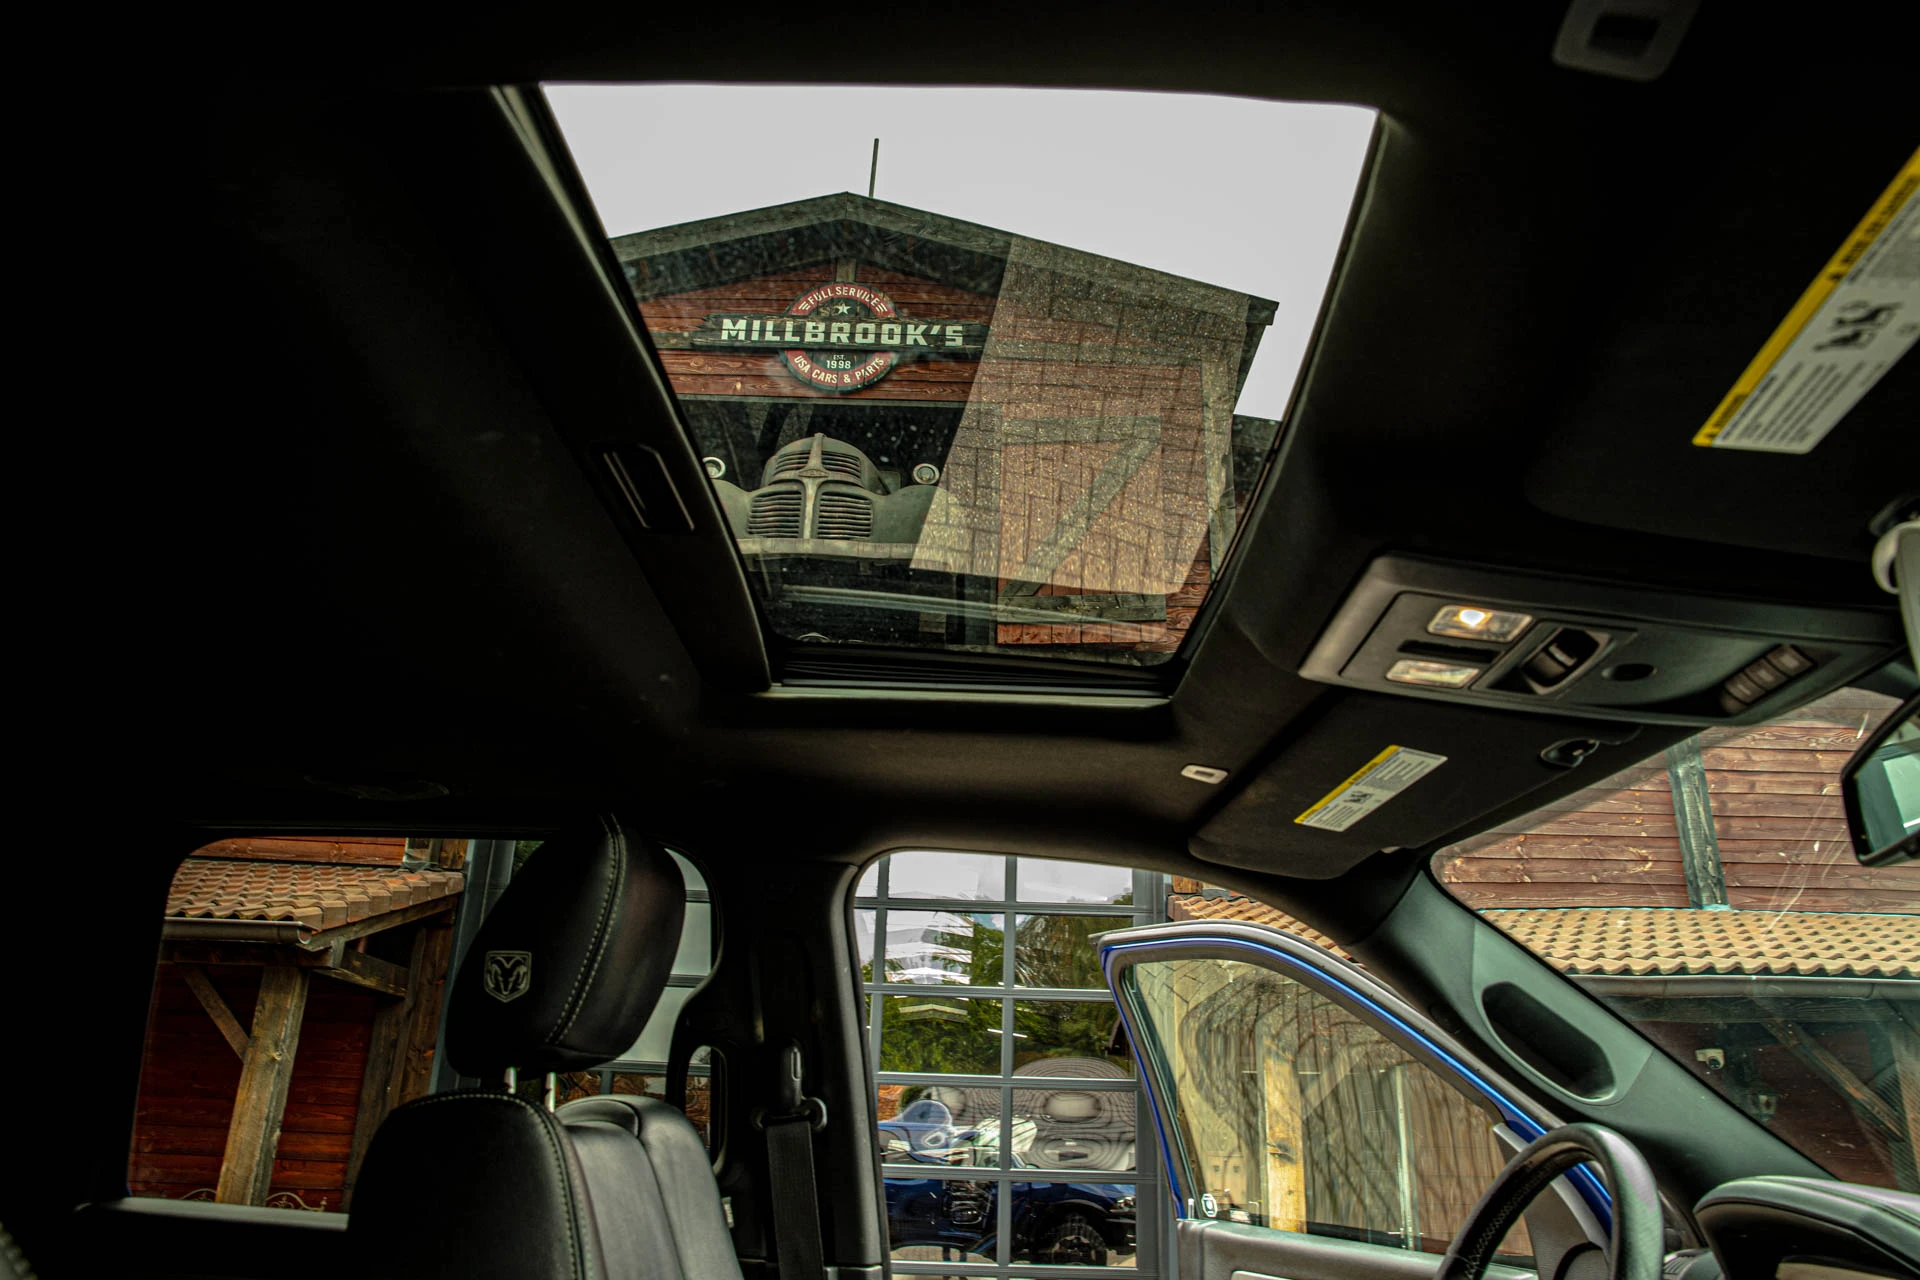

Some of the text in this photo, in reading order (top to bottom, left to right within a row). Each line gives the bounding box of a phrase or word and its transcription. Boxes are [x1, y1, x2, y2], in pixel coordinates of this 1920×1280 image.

[808, 286, 880, 306] FULL SERVICE
[721, 318, 964, 347] MILLBROOK'S
[794, 355, 884, 384] USA CARS & PARTS
[826, 360, 851, 369] 1998
